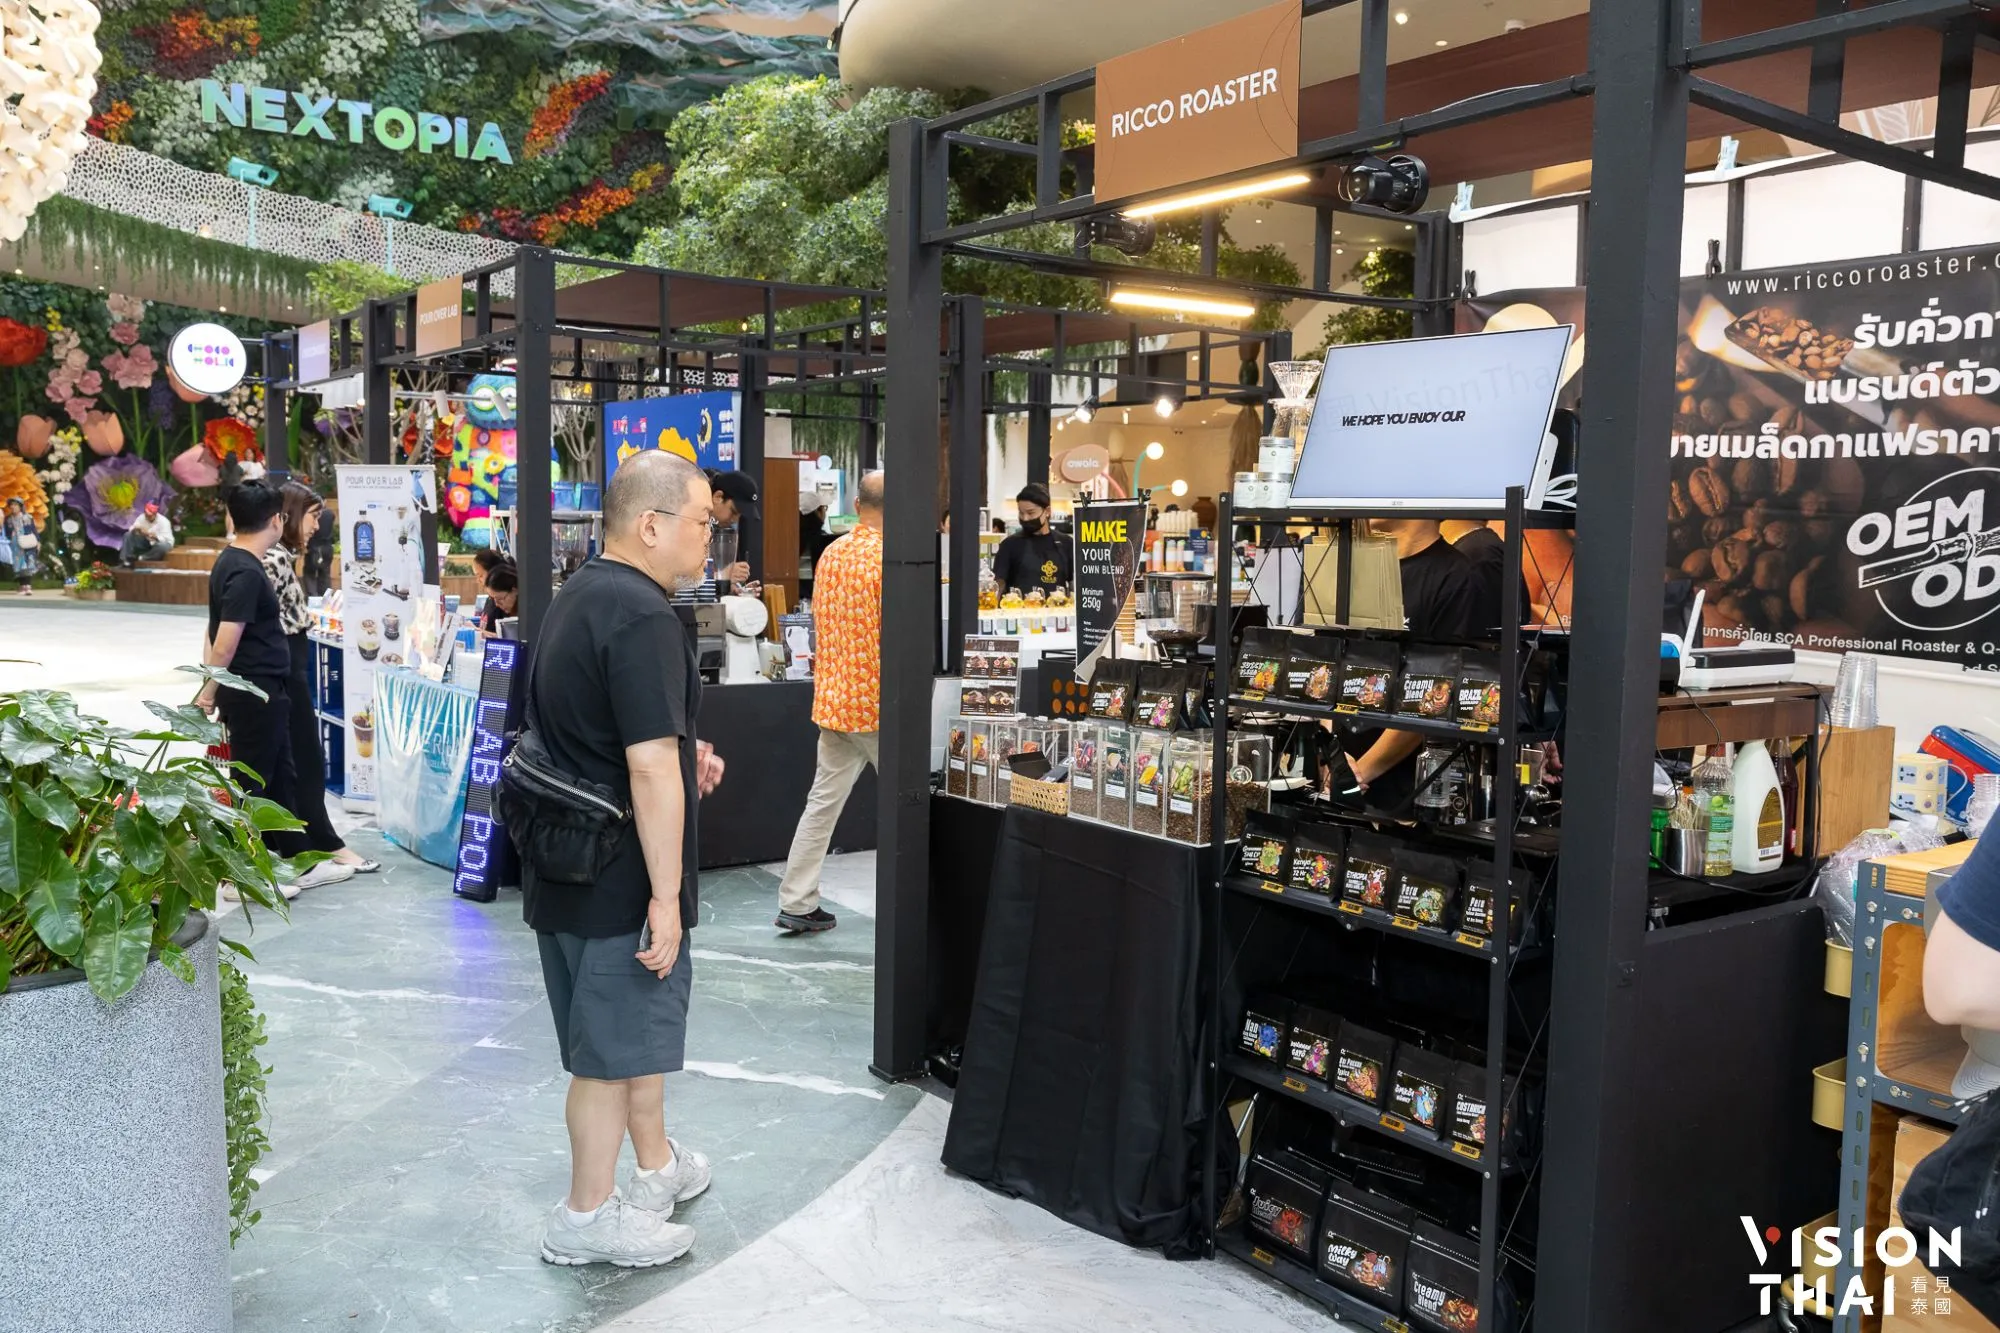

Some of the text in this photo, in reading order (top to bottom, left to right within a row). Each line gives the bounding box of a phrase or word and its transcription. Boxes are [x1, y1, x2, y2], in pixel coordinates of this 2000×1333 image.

[1111, 67, 1278, 138] RICCO ROASTER
[200, 78, 514, 165] NEXTOPIA
[1853, 297, 2000, 349] รับคั่วก
[1342, 410, 1466, 427] WE HOPE YOU ENJOY OUR
[346, 475, 403, 486] POUR OVER LAB
[1846, 488, 1985, 556] OEM
[1081, 520, 1127, 542] MAKE
[1082, 548, 1111, 561] YOUR
[1082, 565, 1125, 575] OWN BLEND
[1082, 587, 1104, 596] Minimum
[1082, 596, 1101, 611] 250g
[1775, 632, 1804, 645] SCA
[1808, 634, 1897, 651] Professional
[1902, 638, 1961, 653] Roaster
[1965, 641, 1976, 654] &
[483, 643, 516, 670] R
[1403, 679, 1434, 692] Creamy
[1404, 690, 1424, 699] Blend
[1459, 689, 1482, 701] BRAZIL
[470, 700, 508, 784] LAB
[1293, 858, 1311, 867] Kenya
[1401, 884, 1419, 896] Peru
[1469, 897, 1485, 908] Peru
[1252, 1196, 1282, 1217] Juicy
[1327, 1243, 1358, 1260] Milky
[1328, 1253, 1350, 1267] Way
[1413, 1280, 1446, 1307] Creamy
[1417, 1294, 1438, 1312] Blend
